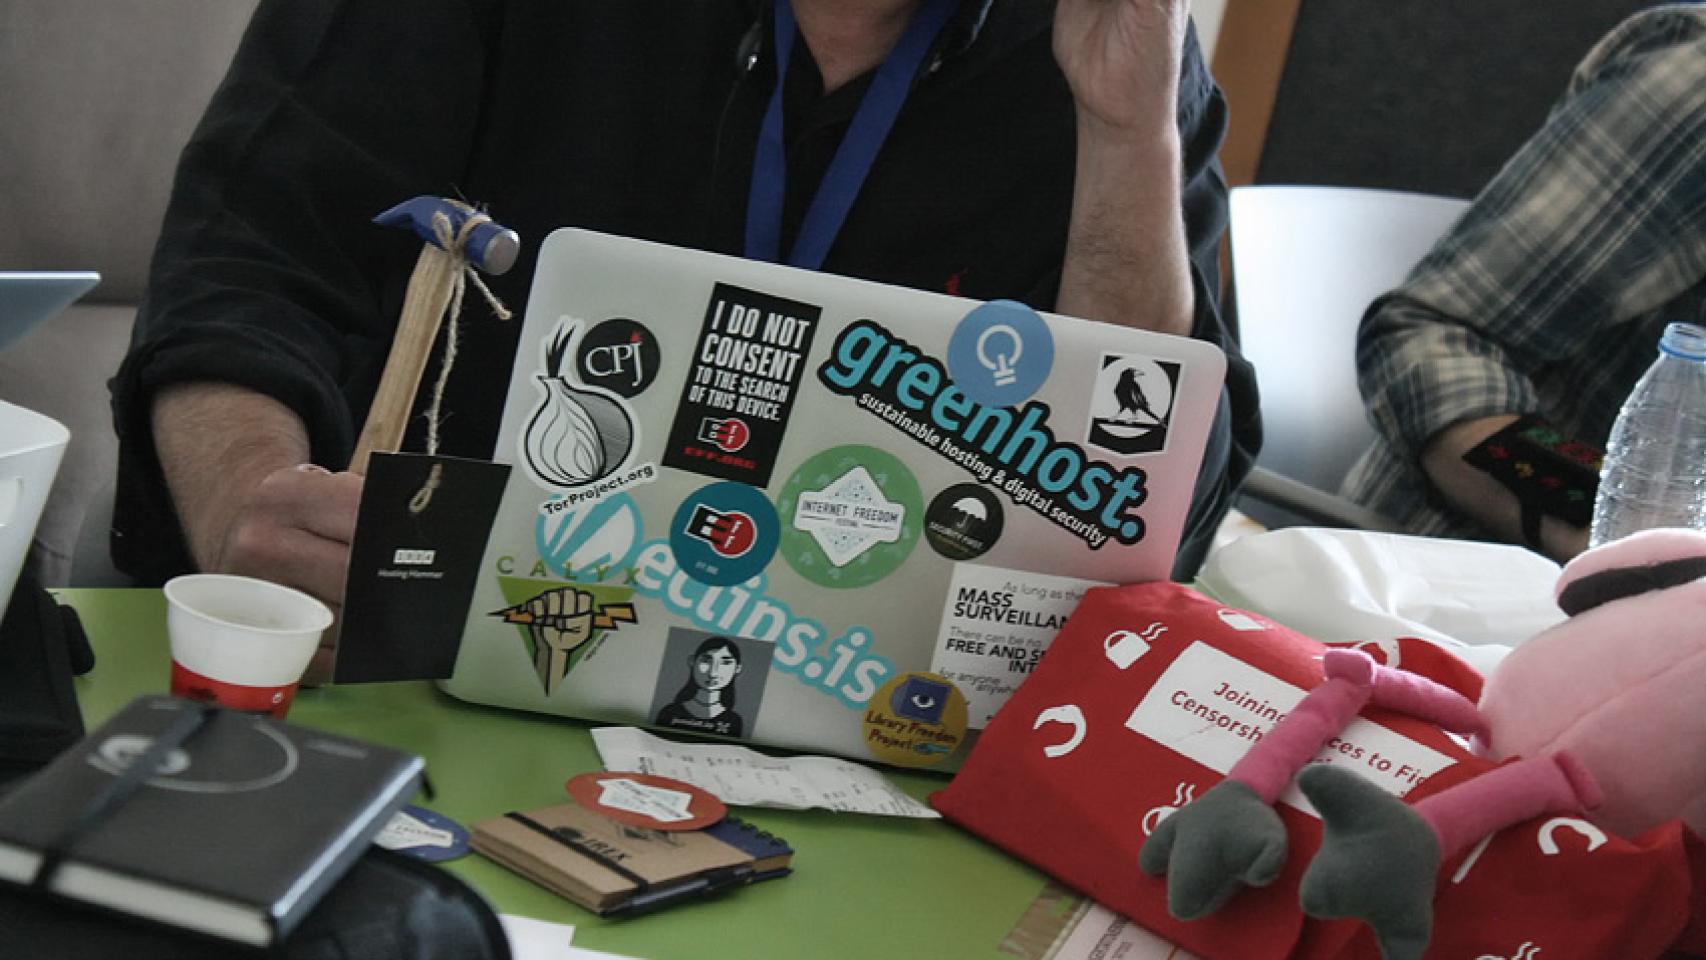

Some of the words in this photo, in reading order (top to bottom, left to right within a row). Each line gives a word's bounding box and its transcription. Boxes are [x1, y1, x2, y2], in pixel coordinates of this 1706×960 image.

[711, 300, 725, 330] I
[726, 304, 761, 338] DO
[762, 312, 811, 349] NOT
[585, 343, 643, 386] CPJ
[701, 332, 802, 383] CONSENT
[688, 385, 708, 403] OF
[706, 388, 737, 411] THIS
[694, 364, 713, 385] TO
[714, 368, 740, 391] THE
[738, 375, 790, 403] SEARCH
[858, 392, 940, 447] sustainable
[939, 437, 994, 481] hosting
[991, 469, 1007, 486] &
[1005, 476, 1054, 515] digital
[1050, 503, 1107, 547] security
[543, 465, 654, 515] TorProject.org
[801, 500, 849, 517] INTERNET
[853, 505, 899, 523] FREEDOM
[496, 555, 641, 586] CALYX
[957, 587, 1014, 608] MASS
[945, 638, 986, 656] FREE
[989, 644, 1026, 660] AND
[1368, 752, 1392, 772] to
